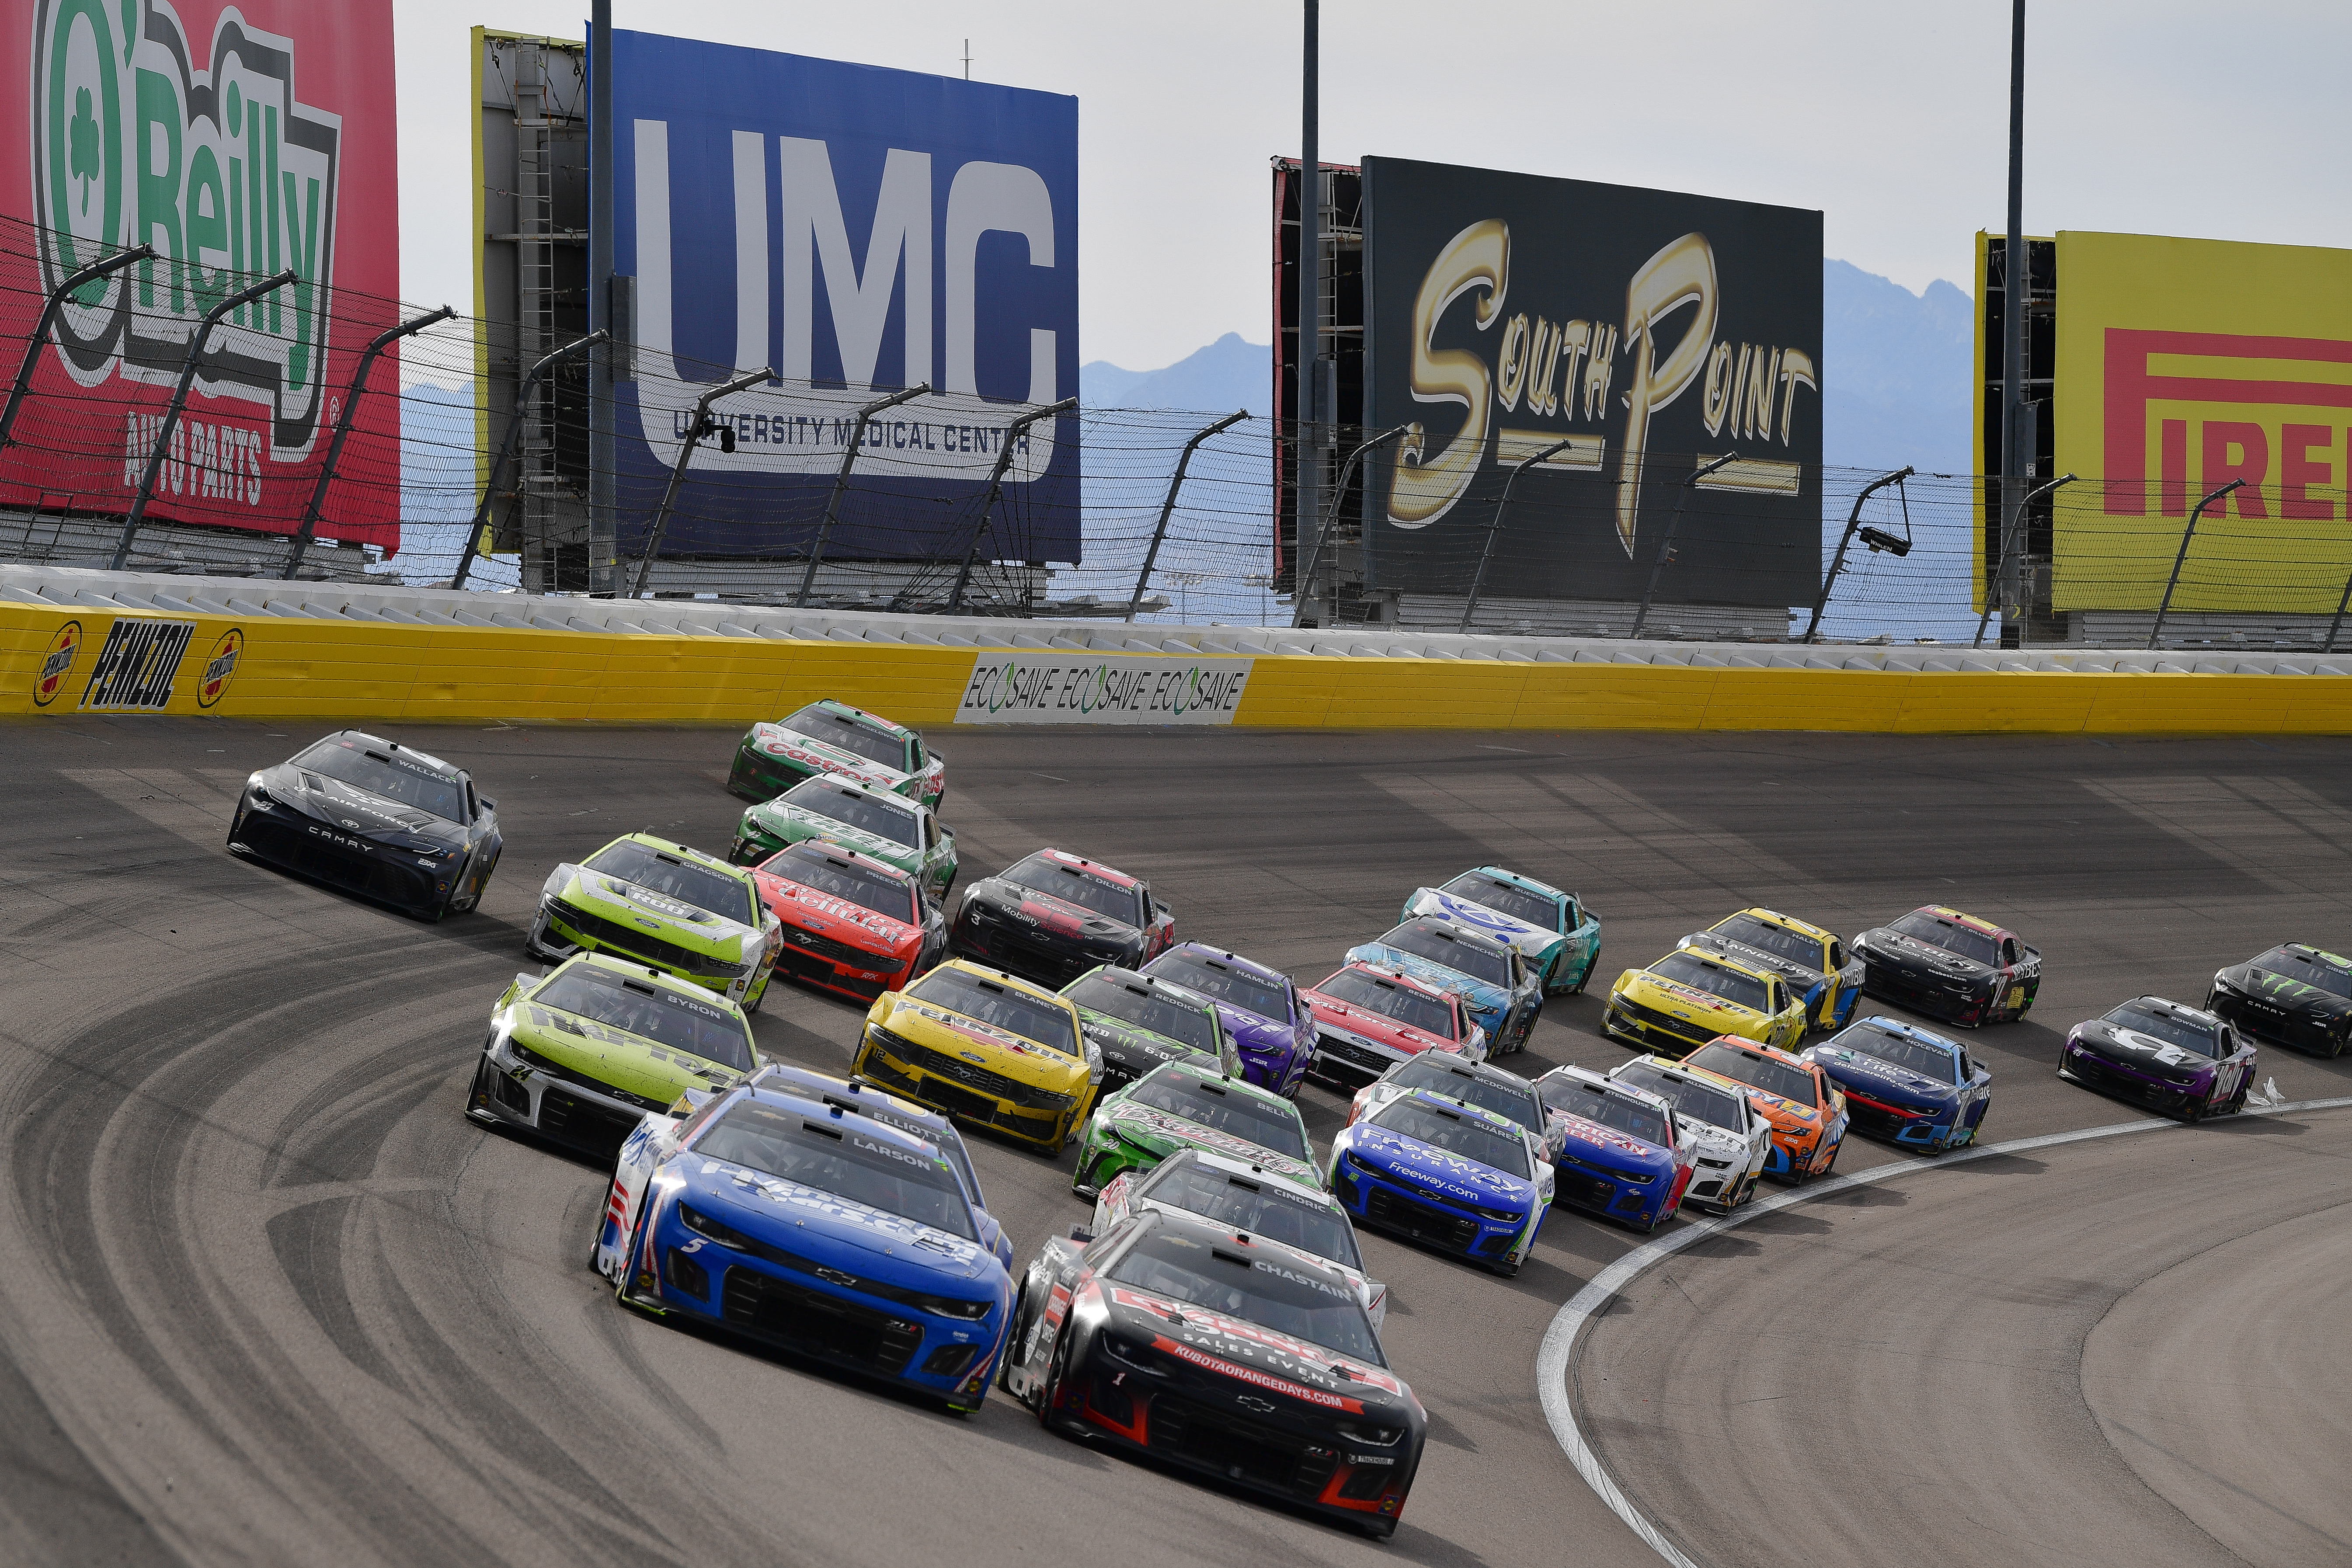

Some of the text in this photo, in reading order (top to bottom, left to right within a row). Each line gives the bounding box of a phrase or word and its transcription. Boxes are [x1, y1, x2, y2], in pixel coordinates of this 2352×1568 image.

[49, 0, 320, 390] O'Reilly
[634, 118, 1056, 420] UMC
[1388, 218, 1817, 560] SOUTH POINT
[674, 410, 824, 445] UIERSITY
[943, 424, 1029, 455] CENTR
[2104, 327, 2352, 522] PIRE
[190, 421, 262, 506] PARTS
[39, 643, 77, 684] PENNZOIL
[77, 617, 198, 710] PENNZOIL
[202, 649, 239, 687] PENNZOIL
[964, 661, 1244, 716] ECOSAVE ECOSAVE ECOSAVE
[856, 722, 901, 743] KESELOWSKI
[398, 760, 453, 784] WALLACE
[254, 800, 274, 812] 23
[293, 786, 418, 834] U.S. AIR FORCE
[880, 803, 913, 820] JONES
[308, 826, 374, 852] CAMRY
[682, 861, 733, 883] GRAGSON
[866, 870, 903, 888] PREECE
[1095, 877, 1132, 896] DILLON
[1514, 887, 1558, 906] BUESCHER
[556, 923, 564, 932] 4
[971, 913, 981, 926] 3
[1792, 933, 1821, 947] HALEY
[1968, 928, 1993, 940] DILLON
[1455, 939, 1501, 960] NEMECHEK
[1715, 939, 1820, 981] GAINBRIDGE
[1868, 943, 1901, 961] seabest.com
[1884, 944, 1920, 958] SEAFOOD
[1236, 970, 1279, 991] HAMLIN
[1725, 967, 1759, 983] LOGANO
[1928, 968, 1967, 982] seabest.com
[2326, 965, 2349, 977] GIBBS
[1014, 991, 1058, 1012] BLANEY
[1155, 992, 1201, 1014] REDDICK
[1407, 988, 1438, 1003] BERRY
[1660, 992, 1712, 1014] ULTRA PLATINUM
[667, 994, 721, 1020] BYRON
[2247, 1000, 2286, 1016] CAMRY
[1082, 1022, 1110, 1038] ARD
[2171, 1016, 2208, 1032] BOWMAN
[873, 1048, 887, 1061] 12
[1906, 1039, 1952, 1058] HOCEVAR
[2072, 1048, 2084, 1058] 48
[1106, 1067, 1140, 1082] MRY
[1774, 1061, 1810, 1077] HERBST
[1474, 1075, 1530, 1100] MCDOWELL
[1686, 1079, 1737, 1101] ALLMENDINGER
[1605, 1089, 1650, 1109] STENHOUSE
[1256, 1102, 1290, 1120] BELL
[873, 1111, 943, 1142] ELLIOTT
[1473, 1121, 1521, 1144] SUÁREZ
[1100, 1137, 1120, 1151] 20
[1564, 1119, 1649, 1156] ERICAN
[853, 1137, 931, 1172] LARSON
[1388, 1161, 1479, 1201] Freeway.com
[1273, 1188, 1326, 1213] CINDRIC
[680, 1238, 709, 1253] 5
[1254, 1261, 1352, 1302] CHASTAIN
[1183, 1332, 1338, 1389] SALES EVENT
[1113, 1372, 1126, 1386] 1
[1174, 1345, 1343, 1408] KUBOTAORANGEDAYS.COM
